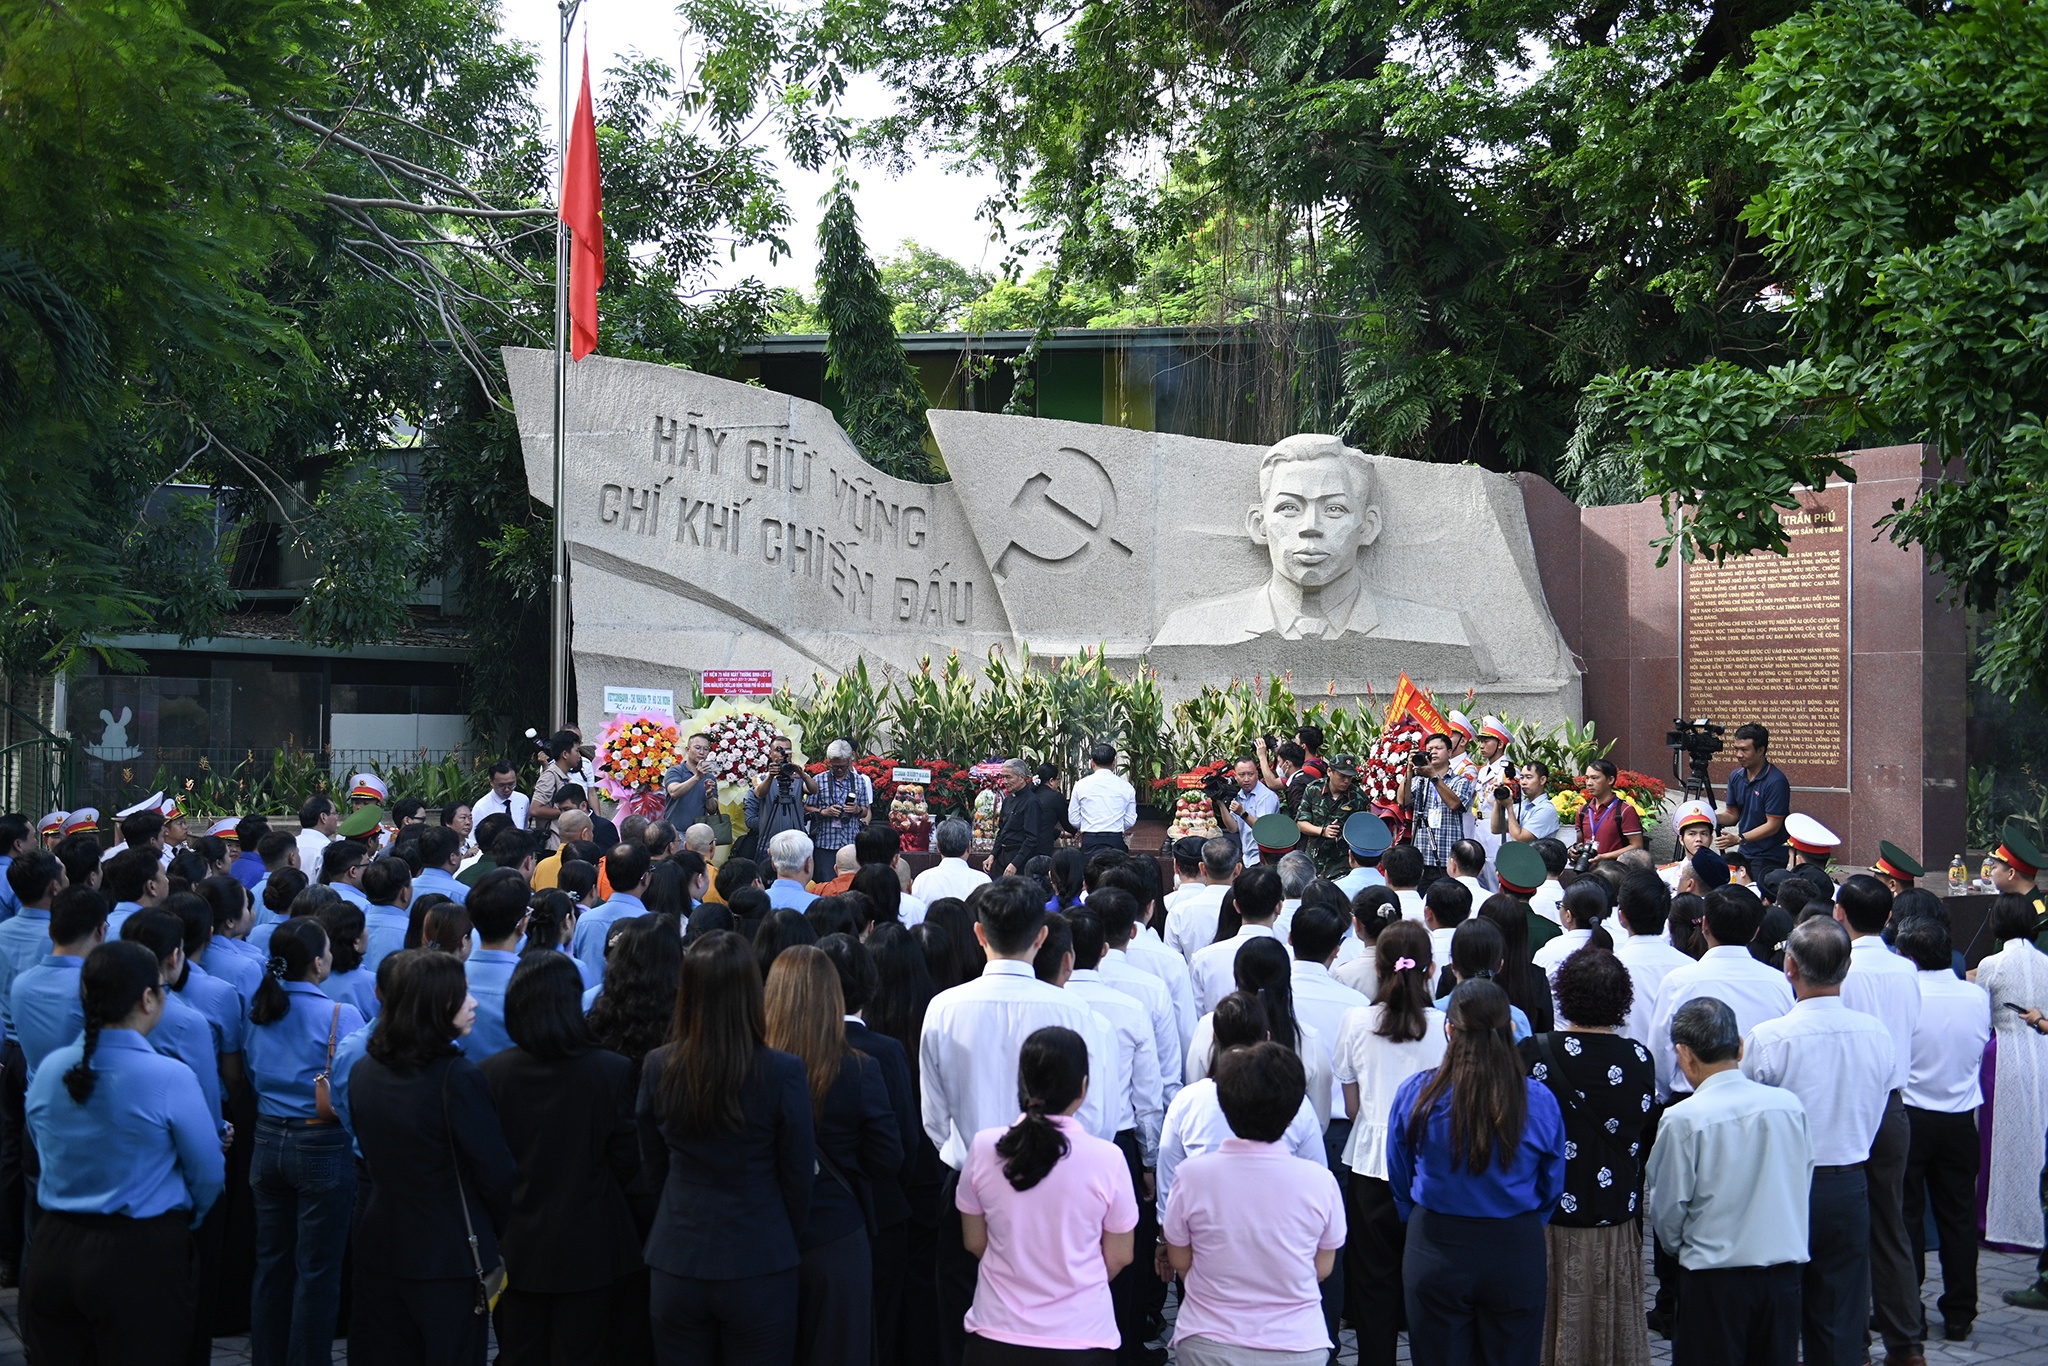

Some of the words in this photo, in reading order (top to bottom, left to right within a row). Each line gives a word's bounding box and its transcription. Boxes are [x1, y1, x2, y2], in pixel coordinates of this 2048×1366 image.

[653, 412, 728, 476] HÃY
[746, 435, 818, 493] GIỮ
[829, 467, 926, 549] VỮNG
[1783, 512, 1811, 525] TRẦN
[1814, 510, 1836, 523] PHÚ
[1800, 527, 1813, 535] SẢN
[1814, 526, 1827, 534] VIỆT
[598, 476, 674, 537] CHÍ
[676, 496, 752, 556] KHÍ
[760, 518, 875, 621] CHIẾN
[893, 562, 974, 628] ĐẤU
[1414, 699, 1432, 722] Kính
